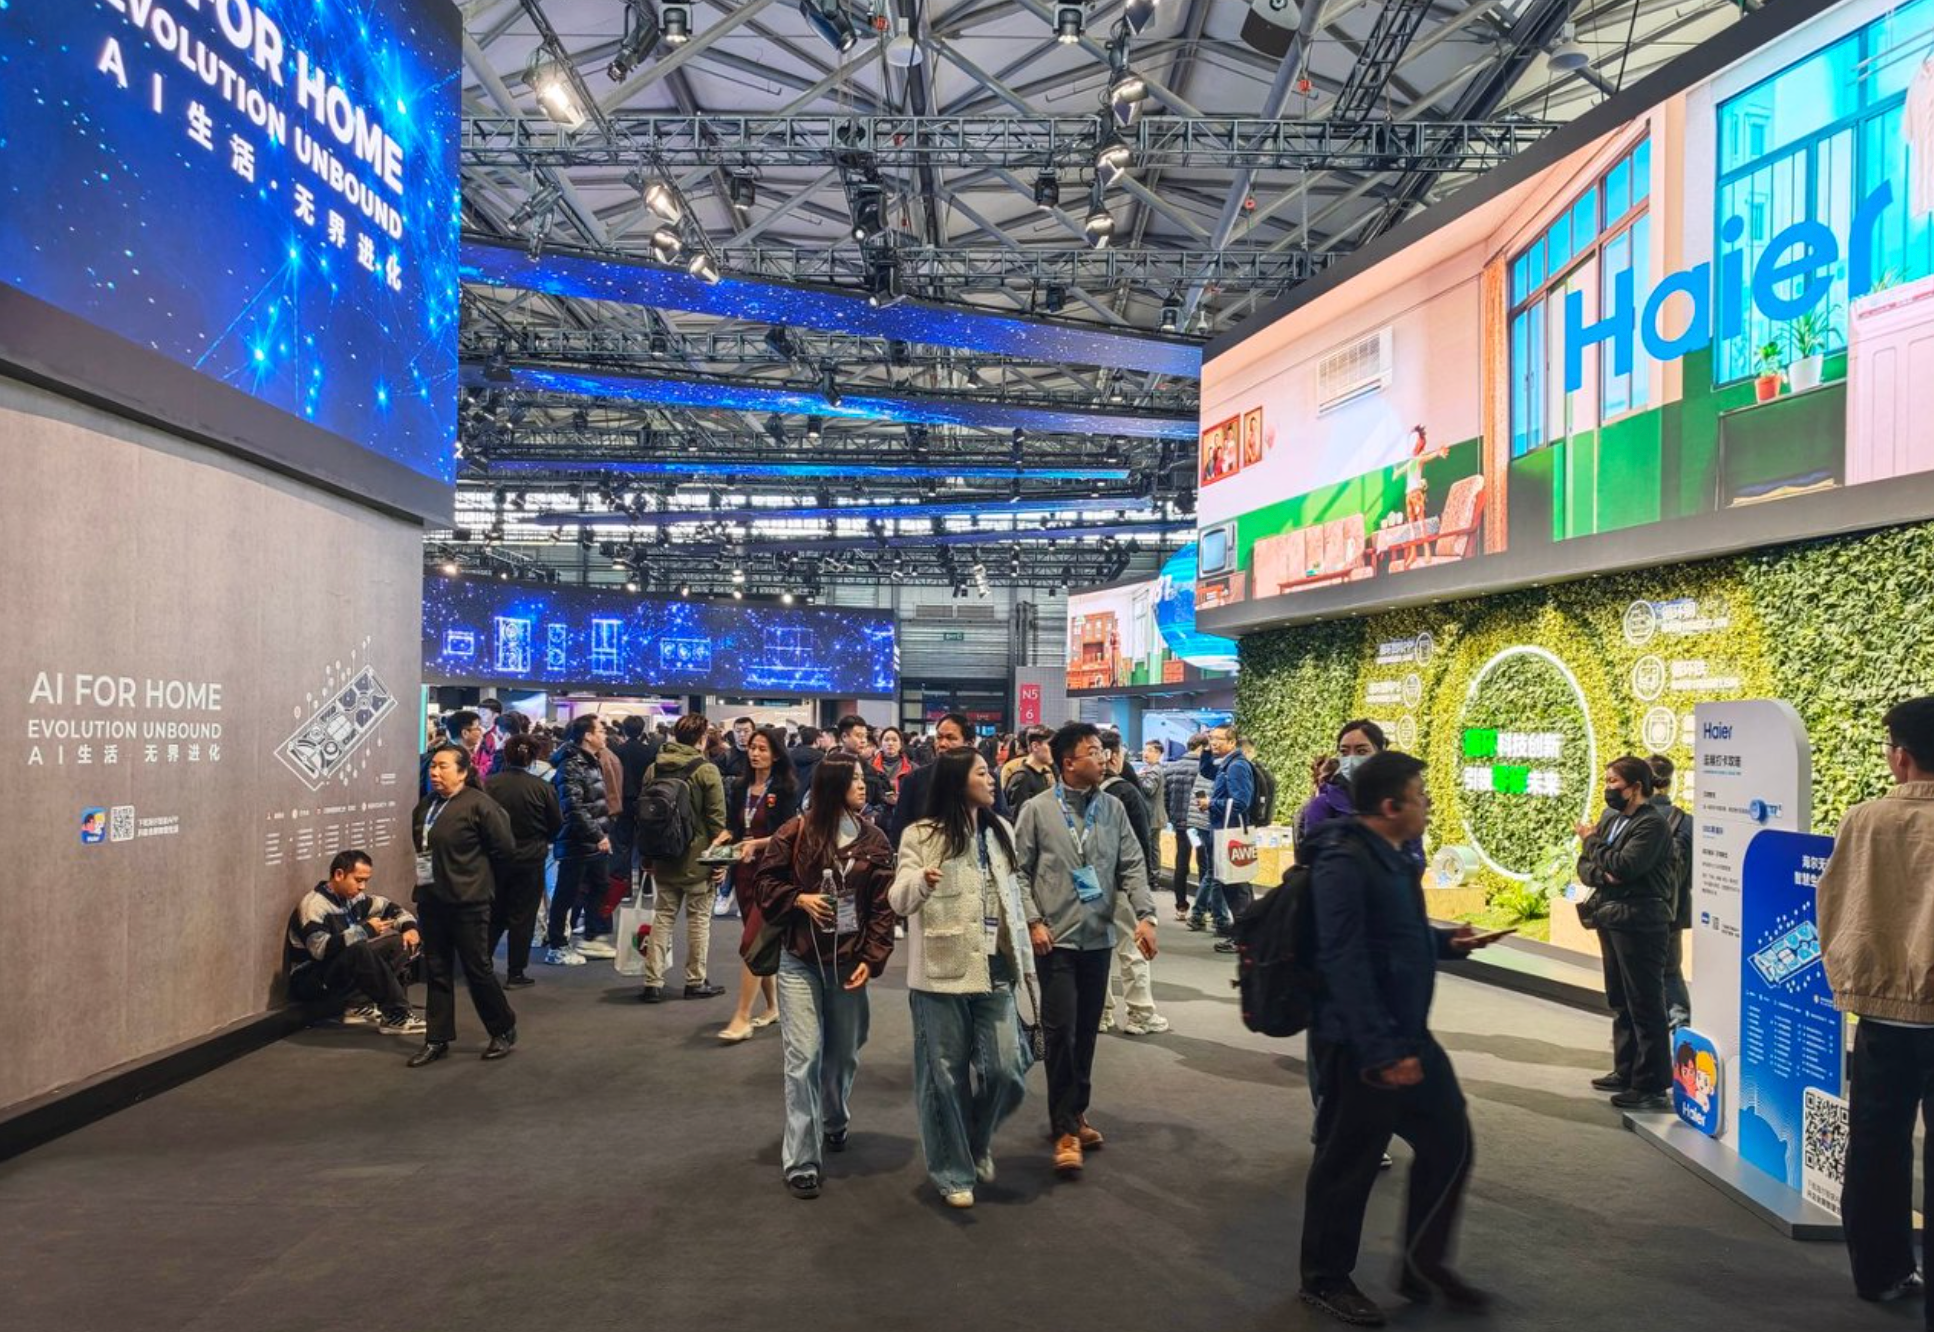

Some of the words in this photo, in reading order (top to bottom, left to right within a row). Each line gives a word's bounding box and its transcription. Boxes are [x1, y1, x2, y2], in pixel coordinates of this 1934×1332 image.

[186, 0, 284, 88] OR
[297, 50, 403, 195] HOME
[105, 0, 286, 146] VOLUTION
[295, 127, 402, 240] UNBOUND
[1565, 179, 1893, 394] Haier
[29, 671, 63, 705] AI
[75, 673, 136, 708] FOR
[145, 679, 222, 711] HOME
[1022, 688, 1038, 700] N5
[1025, 709, 1034, 720] 6
[28, 718, 137, 739] EVOLUTION
[143, 721, 222, 740] UNBOUND
[1703, 721, 1733, 740] Haier
[1231, 846, 1258, 861] AWE
